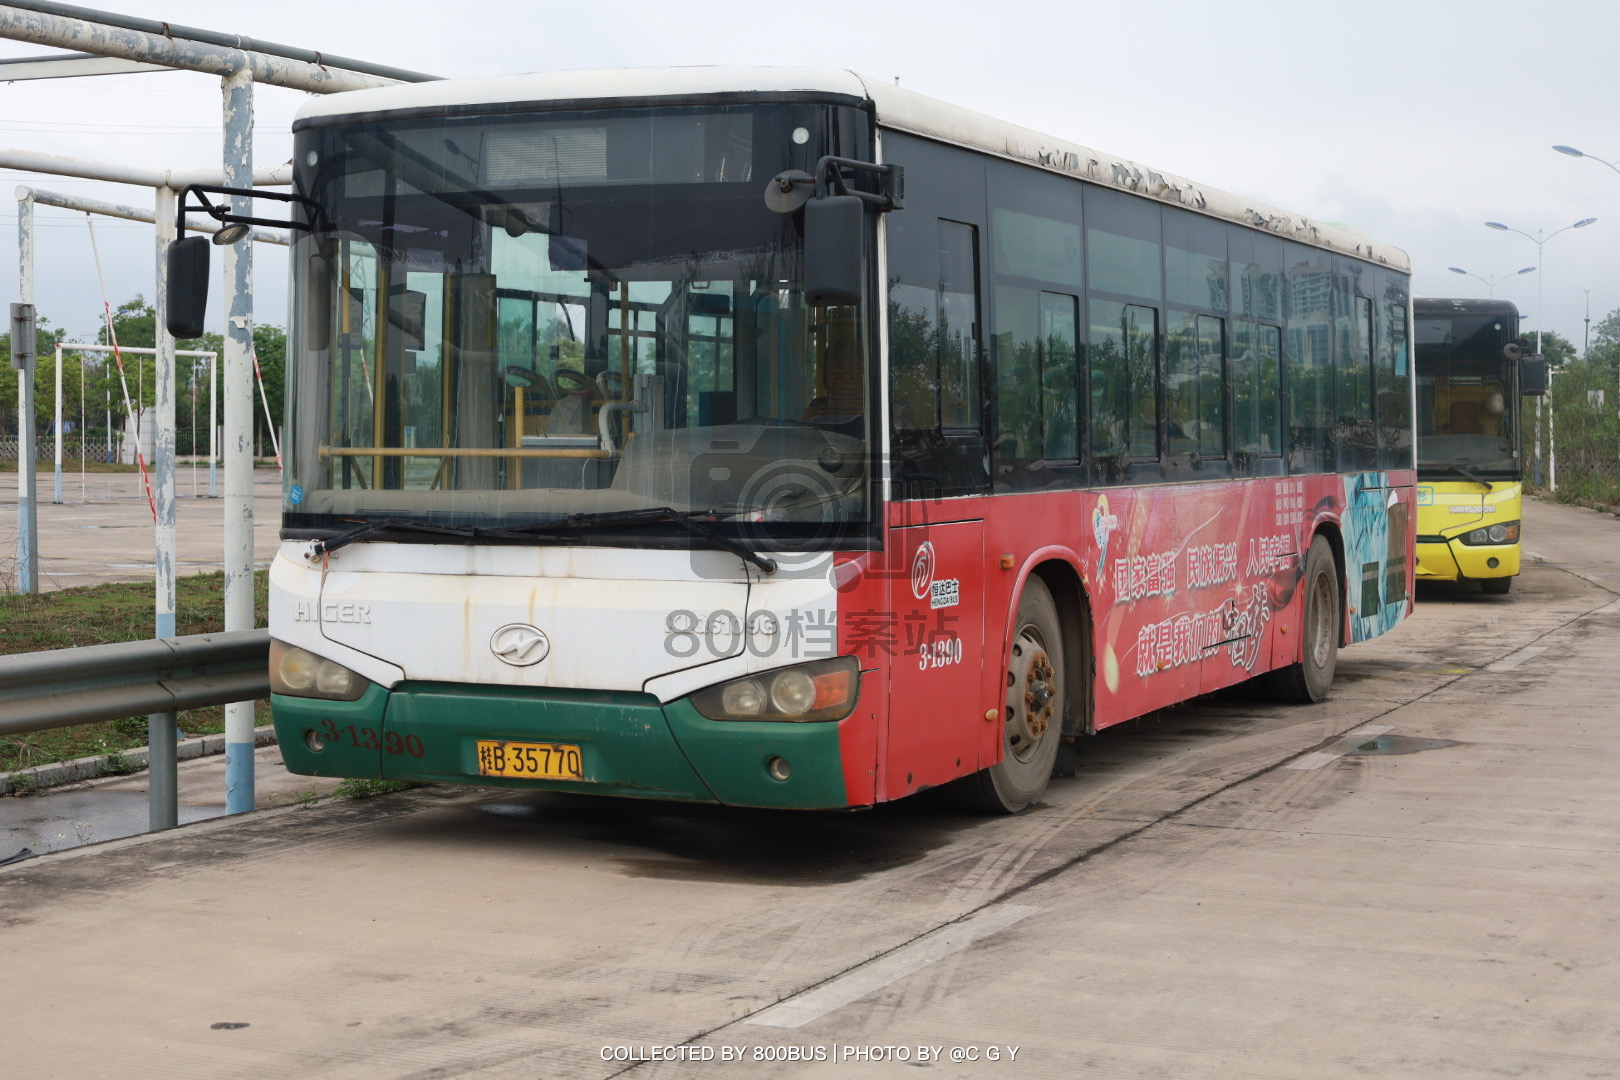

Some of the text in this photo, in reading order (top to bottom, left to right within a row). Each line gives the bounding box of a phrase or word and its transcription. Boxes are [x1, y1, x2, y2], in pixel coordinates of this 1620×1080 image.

[1115, 534, 1291, 603] 国家富强 民族振兴 人民幸福
[932, 580, 958, 597] 恒达巴士
[294, 602, 371, 624] HIGER
[919, 638, 963, 671] 3-1390
[320, 718, 425, 758] 3-1390
